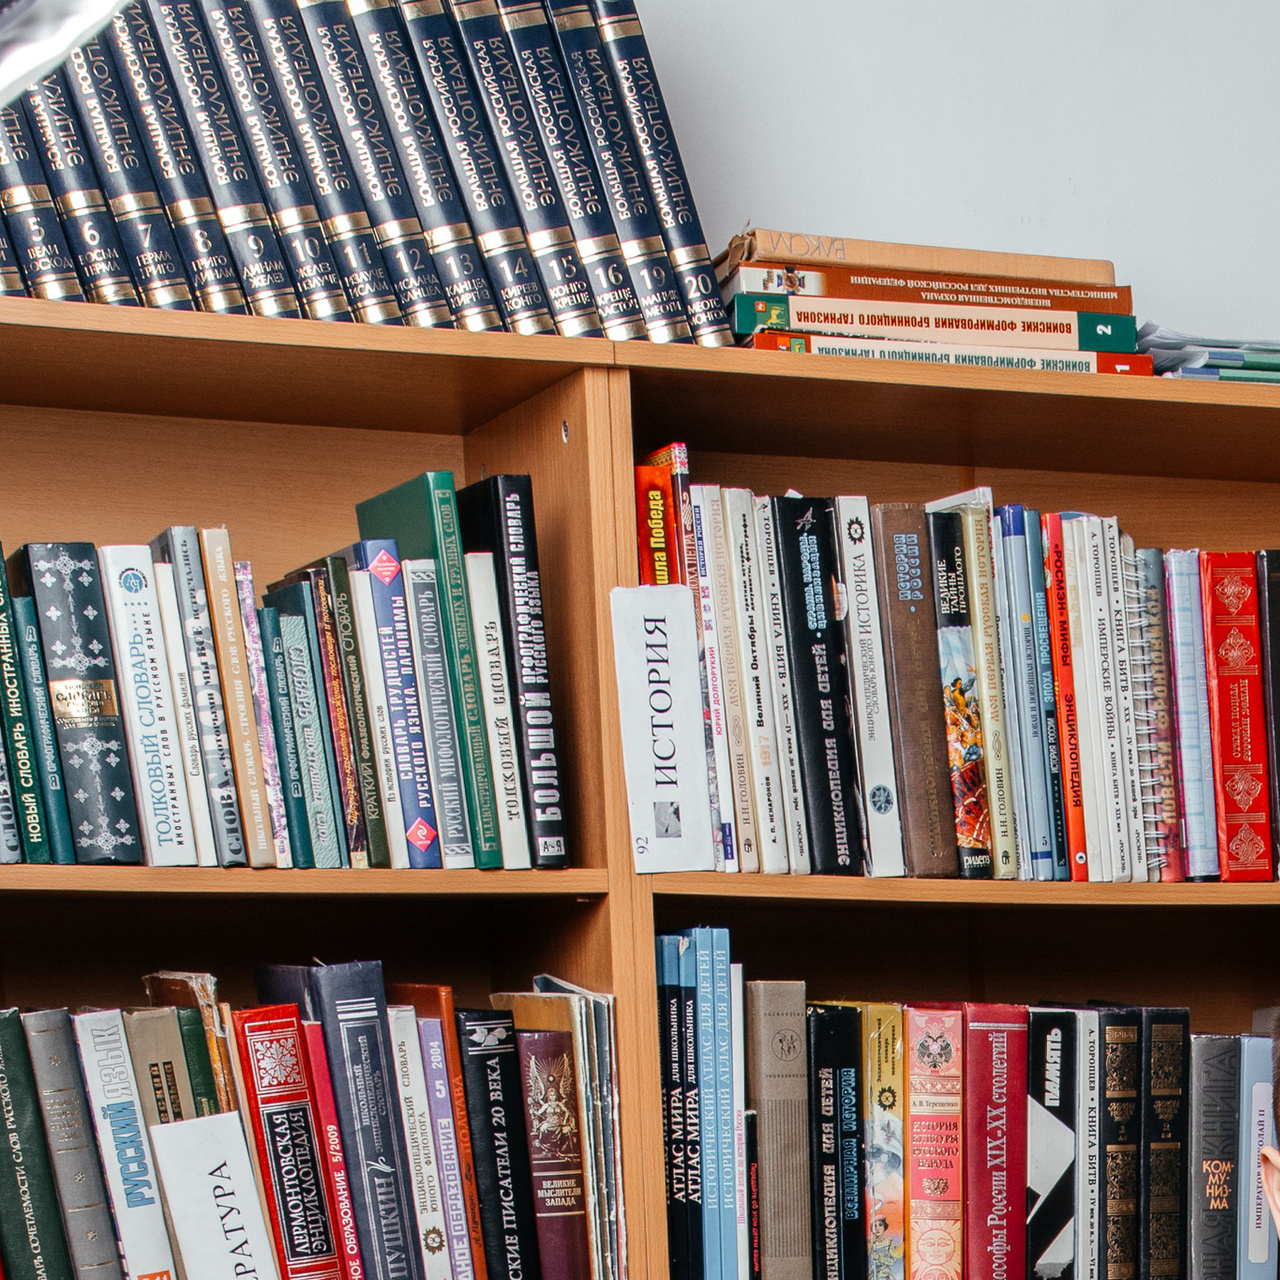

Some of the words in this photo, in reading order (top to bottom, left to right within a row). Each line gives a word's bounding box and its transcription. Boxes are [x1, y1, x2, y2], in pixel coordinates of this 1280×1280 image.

[423, 40, 464, 138] РОССИЙСКАЯ
[617, 59, 654, 156] РОССИЙСКАЯ
[438, 37, 506, 207] ЭНЦИКЛОПЕДИЯ
[632, 57, 693, 224] ЭНЦИКЛОПЕДИЯ
[456, 141, 488, 211] БОЛЬШАЯ
[646, 160, 675, 228] БОЛЬШАЯ
[500, 256, 528, 282] 14
[549, 255, 576, 279] 15
[685, 274, 712, 299] 20
[850, 275, 905, 288] ФЕДЕРАЦИИ
[906, 279, 969, 290] РОССИЙСКОЙ
[971, 284, 987, 292] ДЕЛ
[989, 284, 1047, 295] ВНУТРЕННИХ
[795, 310, 854, 326] ГАРНИЗОНА
[921, 292, 956, 302] ОХРАНА
[958, 294, 1050, 307] ВНЕВЕДОМСТВЕННАЯ
[1050, 289, 1118, 299] МИНИСТЕРСТВА
[859, 313, 930, 330] БРОННИЦКОГО
[935, 316, 1017, 332] ФОРМИРОВАНИЯ
[1021, 320, 1072, 334] ВОИНСКИЕ
[1096, 324, 1112, 335] 2
[505, 493, 526, 551] СЛОВАРЬ
[526, 570, 542, 617] ЯЗЫКА
[936, 559, 950, 616] ВЕЛИКИЕ
[949, 572, 960, 615] ТАЙНЫ
[953, 546, 968, 614] ПРОШЛОГО
[141, 612, 156, 650] ЯЗЫКЕ
[391, 596, 416, 675] ПАРОНИМЫ
[508, 556, 537, 684] ОРФОГРАФИЧЕСКИЙ
[0, 611, 24, 718] ИНОСТРАННЫХ
[378, 626, 404, 713] ТРУДНОСТЕЙ
[530, 619, 549, 684] РУССКОГО
[813, 642, 831, 693] ДЕТЕЙ
[1059, 624, 1071, 668] МИФЫ
[150, 657, 166, 709] РУССКОМ
[643, 614, 679, 788] ИСТОРИЯ
[821, 698, 836, 732] ДЛЯ
[12, 722, 34, 788] СЛОВАРЬ
[162, 728, 173, 757] СЛОВ
[391, 718, 414, 781] СЛОВАРЬ
[519, 691, 562, 822] БОЛЬШОЙ
[1064, 693, 1082, 809] ЭНЦИКЛОПЕДИЯ
[141, 734, 174, 847] ТОЛКОВЫЙ
[412, 744, 432, 809] РУССКОГО
[20, 793, 43, 843] НОВЫЙ
[164, 763, 185, 847] ИНОСТРАННЫХ
[824, 737, 851, 867] ЭНЦИКЛОПЕДИЯ
[635, 836, 650, 855] 92
[683, 999, 695, 1060] ШКОЛЬНИКА
[90, 1024, 136, 1100] ЯЗЫК
[486, 1055, 505, 1104] ВЕКА
[686, 1061, 697, 1085] ДЛЯ
[988, 1031, 1008, 1103] столетий
[1044, 1027, 1062, 1107] ПАМЯТЬ
[491, 1106, 507, 1128] 20
[685, 1085, 700, 1139] МИРА
[912, 1121, 958, 1133] ИСТОРИЯ
[102, 1100, 155, 1209] РУССКИЙ
[327, 1124, 345, 1163] 5/2009
[912, 1146, 959, 1158] РУССКОГО
[917, 1158, 954, 1170] НАРОДА
[1202, 1159, 1234, 1174] КОМ-
[275, 1111, 312, 1256] ЛЕРМОНТОВСКАЯ
[293, 1111, 329, 1254] ЭНЦИКЛОПЕДИЯ
[490, 1128, 518, 1230] ПИСАТЕЛИ
[537, 1187, 582, 1199] МЫСЛИТЕЛИ
[541, 1179, 578, 1190] ВЕЛИКИЕ
[686, 1142, 703, 1204] АТЛАС
[986, 1171, 1008, 1223] России
[1205, 1185, 1232, 1198] НИЗ-
[1207, 1173, 1230, 1185] МУ-
[334, 1168, 358, 1256] ОБРАЗОВАНИЕ
[544, 1195, 577, 1207] ЗАПАДА
[1209, 1198, 1229, 1211] МА
